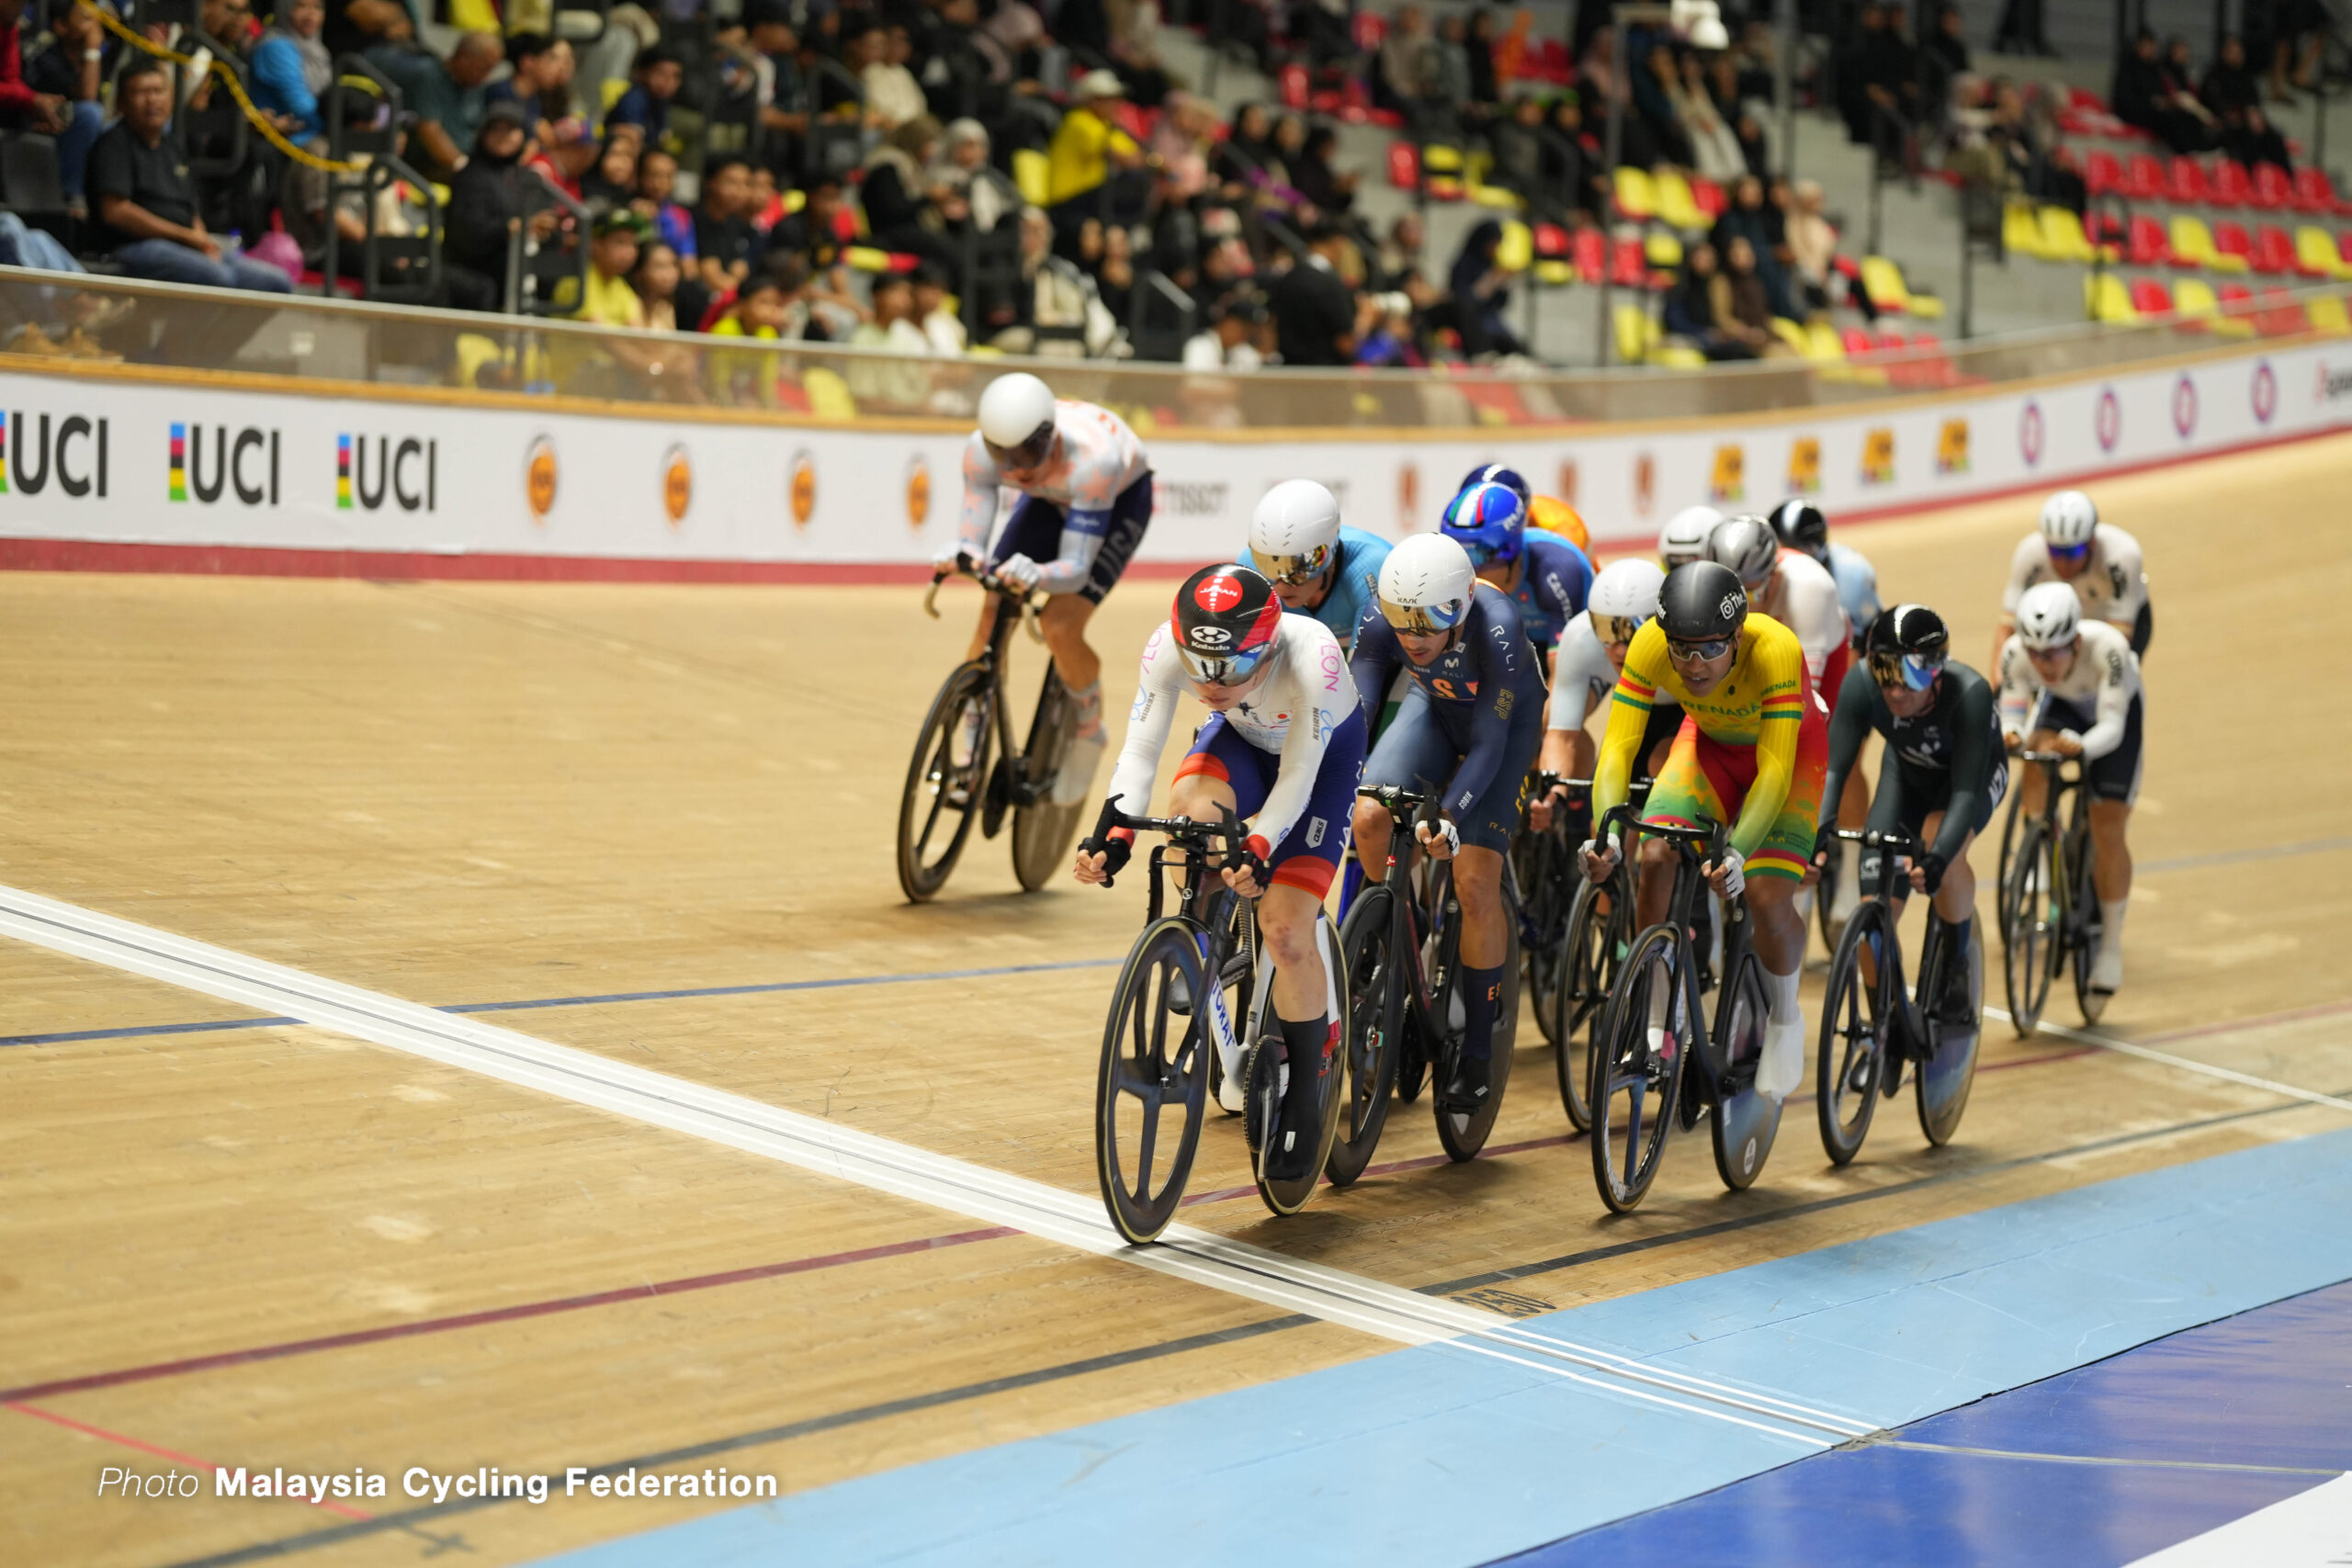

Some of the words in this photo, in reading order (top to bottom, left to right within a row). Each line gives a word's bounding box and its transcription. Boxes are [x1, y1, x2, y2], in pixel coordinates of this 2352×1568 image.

[11, 411, 108, 499] UCI
[191, 423, 280, 506] UCI
[356, 434, 436, 513] UCI
[1191, 640, 1231, 651] Kabuto
[1139, 692, 1156, 722] KEIRIN
[1311, 706, 1320, 741] KEIRIN
